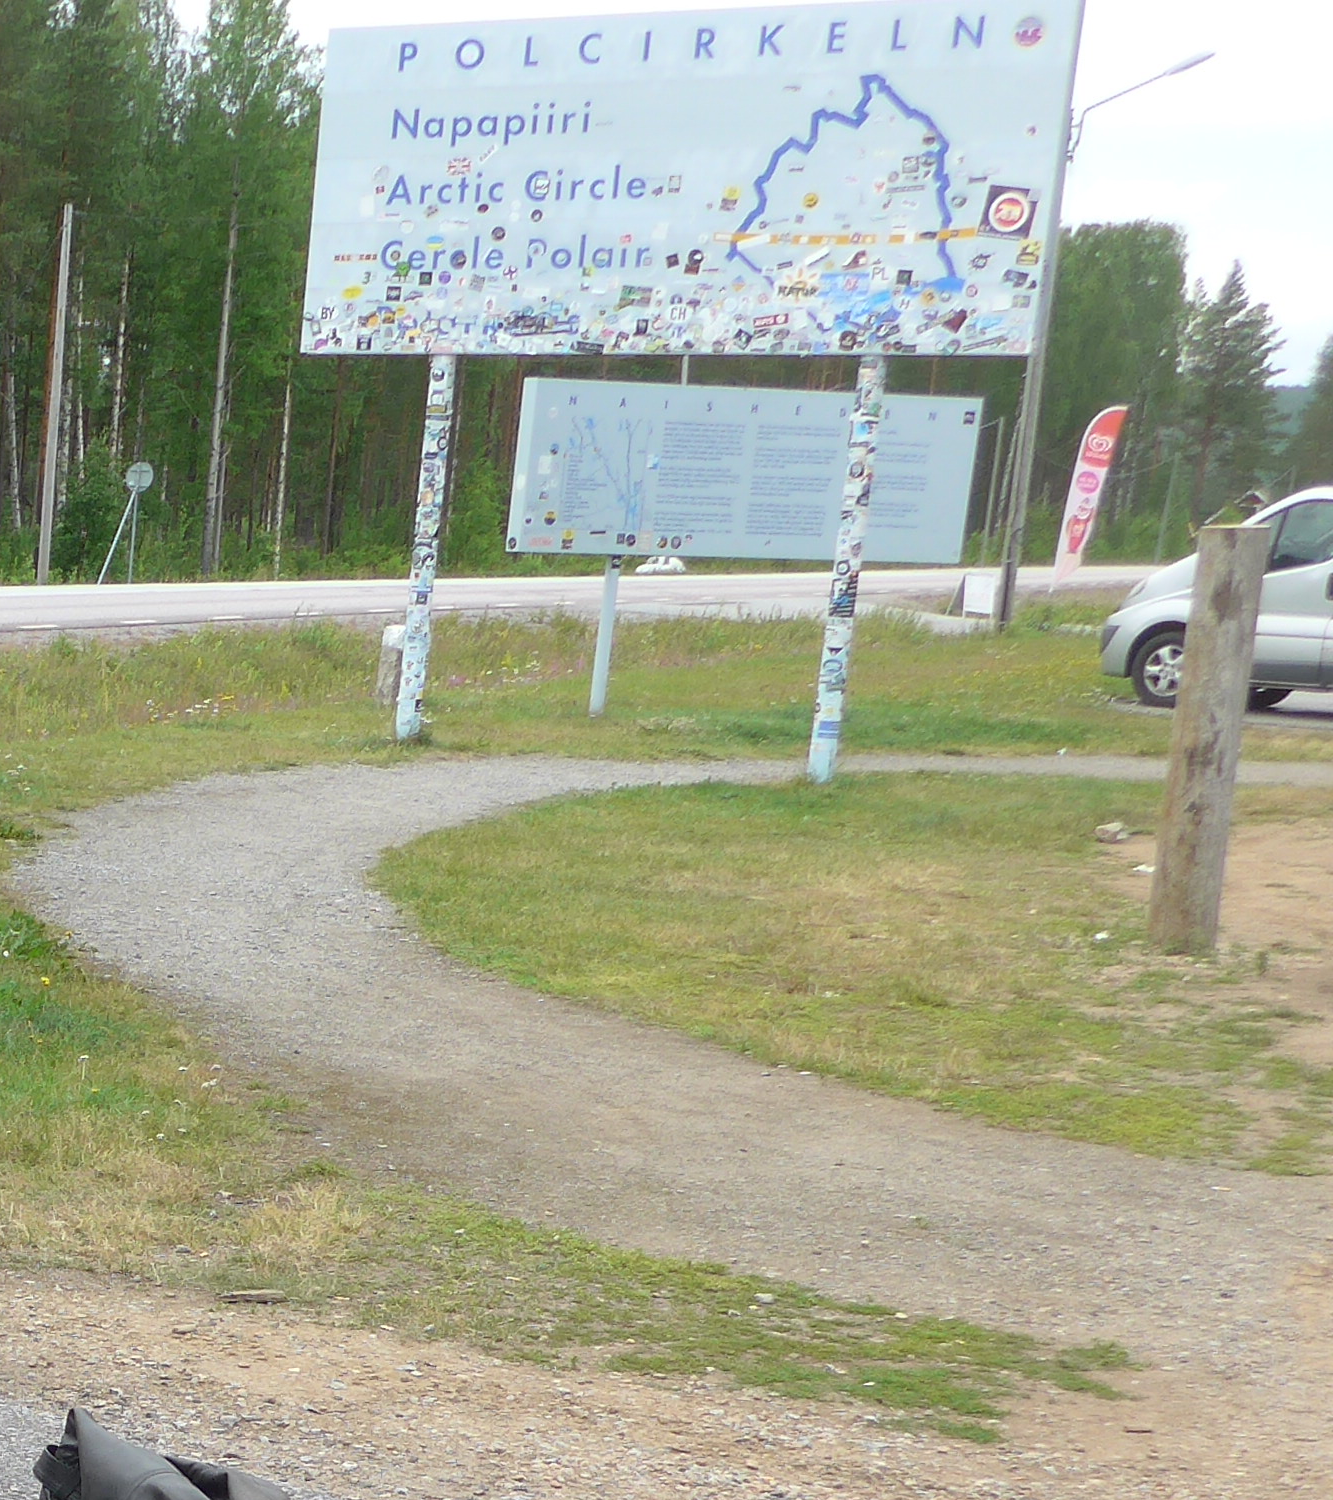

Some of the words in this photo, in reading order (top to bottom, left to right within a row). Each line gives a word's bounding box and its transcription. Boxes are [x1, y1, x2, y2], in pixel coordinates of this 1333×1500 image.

[397, 14, 986, 73] POLCIRKELN
[390, 101, 592, 147] Napapiiri
[386, 172, 505, 206] Arctic
[525, 164, 647, 202] Circle
[670, 306, 687, 321] CH
